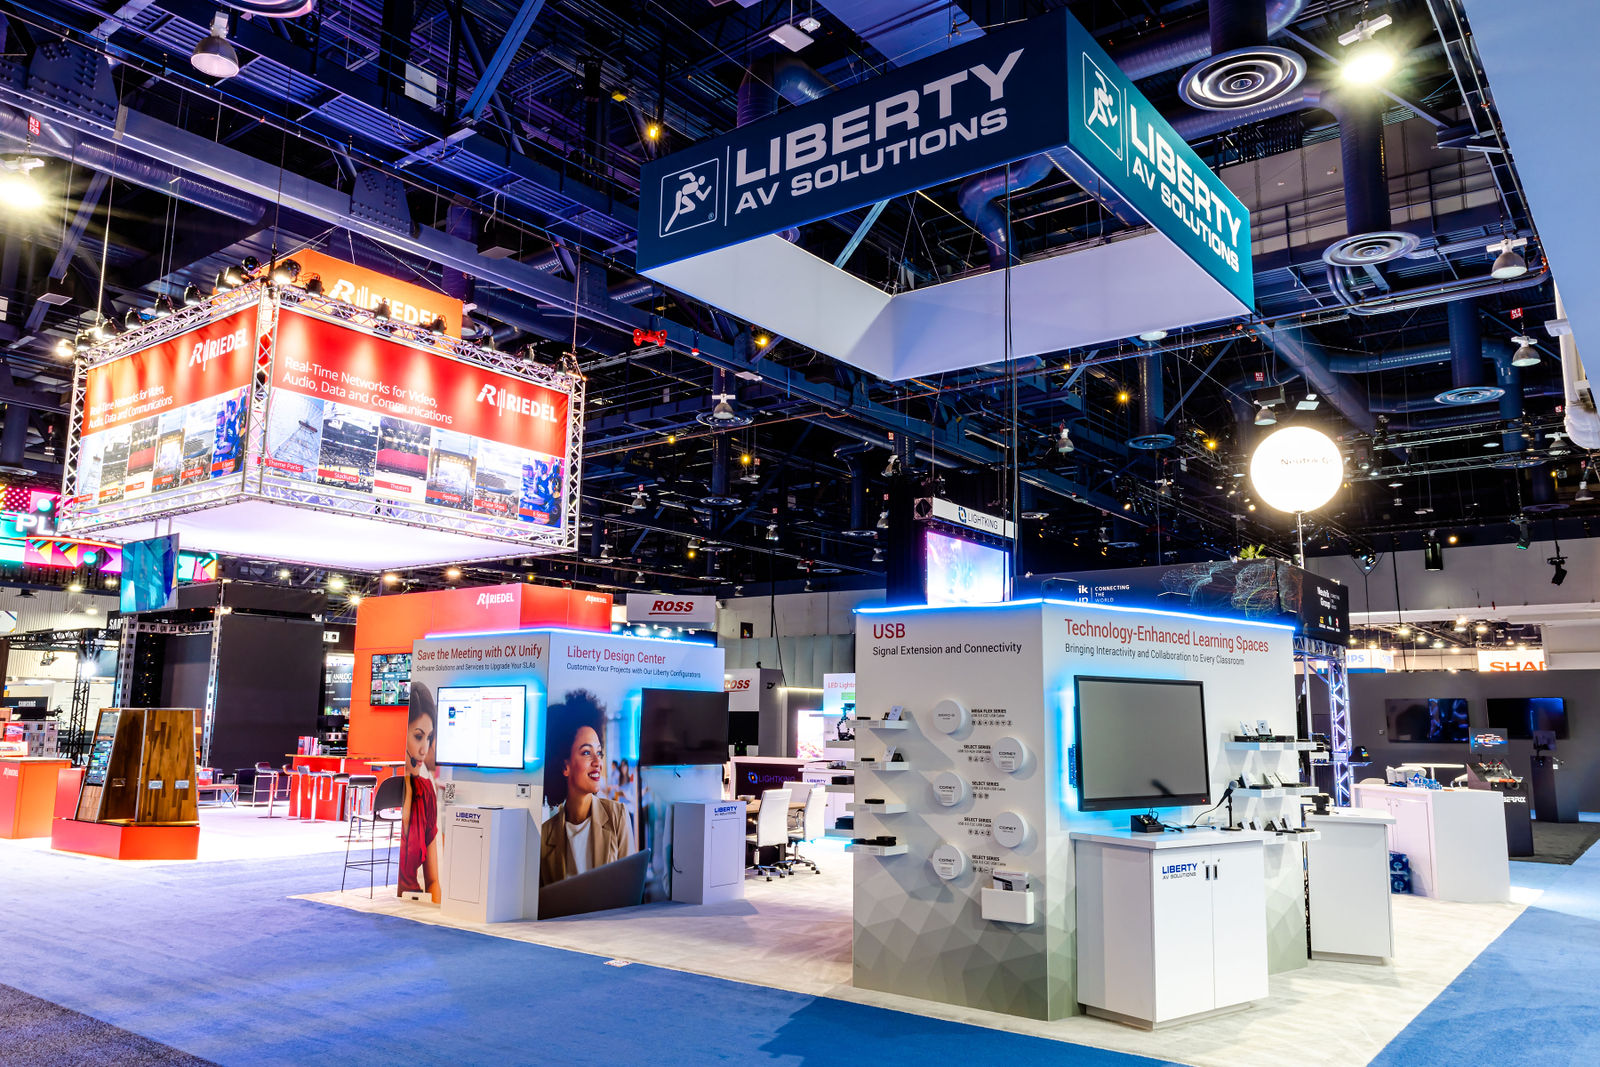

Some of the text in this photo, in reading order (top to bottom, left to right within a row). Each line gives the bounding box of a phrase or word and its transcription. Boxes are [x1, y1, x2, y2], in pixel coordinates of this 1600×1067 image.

[736, 48, 1025, 187] LIBERTY
[735, 107, 1008, 215] AV SOLUTIONS
[1130, 104, 1241, 248] LIBERTY
[1133, 156, 1239, 273] AV SOLUTIONS
[210, 328, 248, 360] RIEDEL
[285, 356, 438, 408] Real-Time Networks for Video,
[282, 373, 453, 424] Audio, Data and Communications
[506, 394, 557, 423] RIEDEL
[268, 459, 302, 472] Theme Parks
[334, 472, 357, 482] Stadiums
[968, 513, 998, 530] LIGHTKING
[490, 592, 514, 604] RIEDEL
[652, 600, 694, 612] ROSS
[873, 623, 906, 639] USB
[1064, 618, 1269, 654] Technology-Enhanced Learning Spaces
[417, 643, 542, 661] Save the Meeting with CX Unify
[567, 645, 666, 665] Liberty Design Center
[872, 642, 1022, 657] Signal Extension and Connectivity
[1065, 643, 1245, 665] Bringing Interactivity and Collaboration to Every Classroom
[490, 661, 510, 671] Upgrade
[566, 663, 596, 671] Customize
[597, 664, 609, 673] Your
[610, 666, 631, 675] Projects
[653, 669, 669, 677] Liberty
[670, 670, 701, 679] Configurators
[456, 812, 481, 820] LIBERTY
[714, 805, 738, 814] LIBERTY
[1162, 863, 1198, 874] LIBERTY
